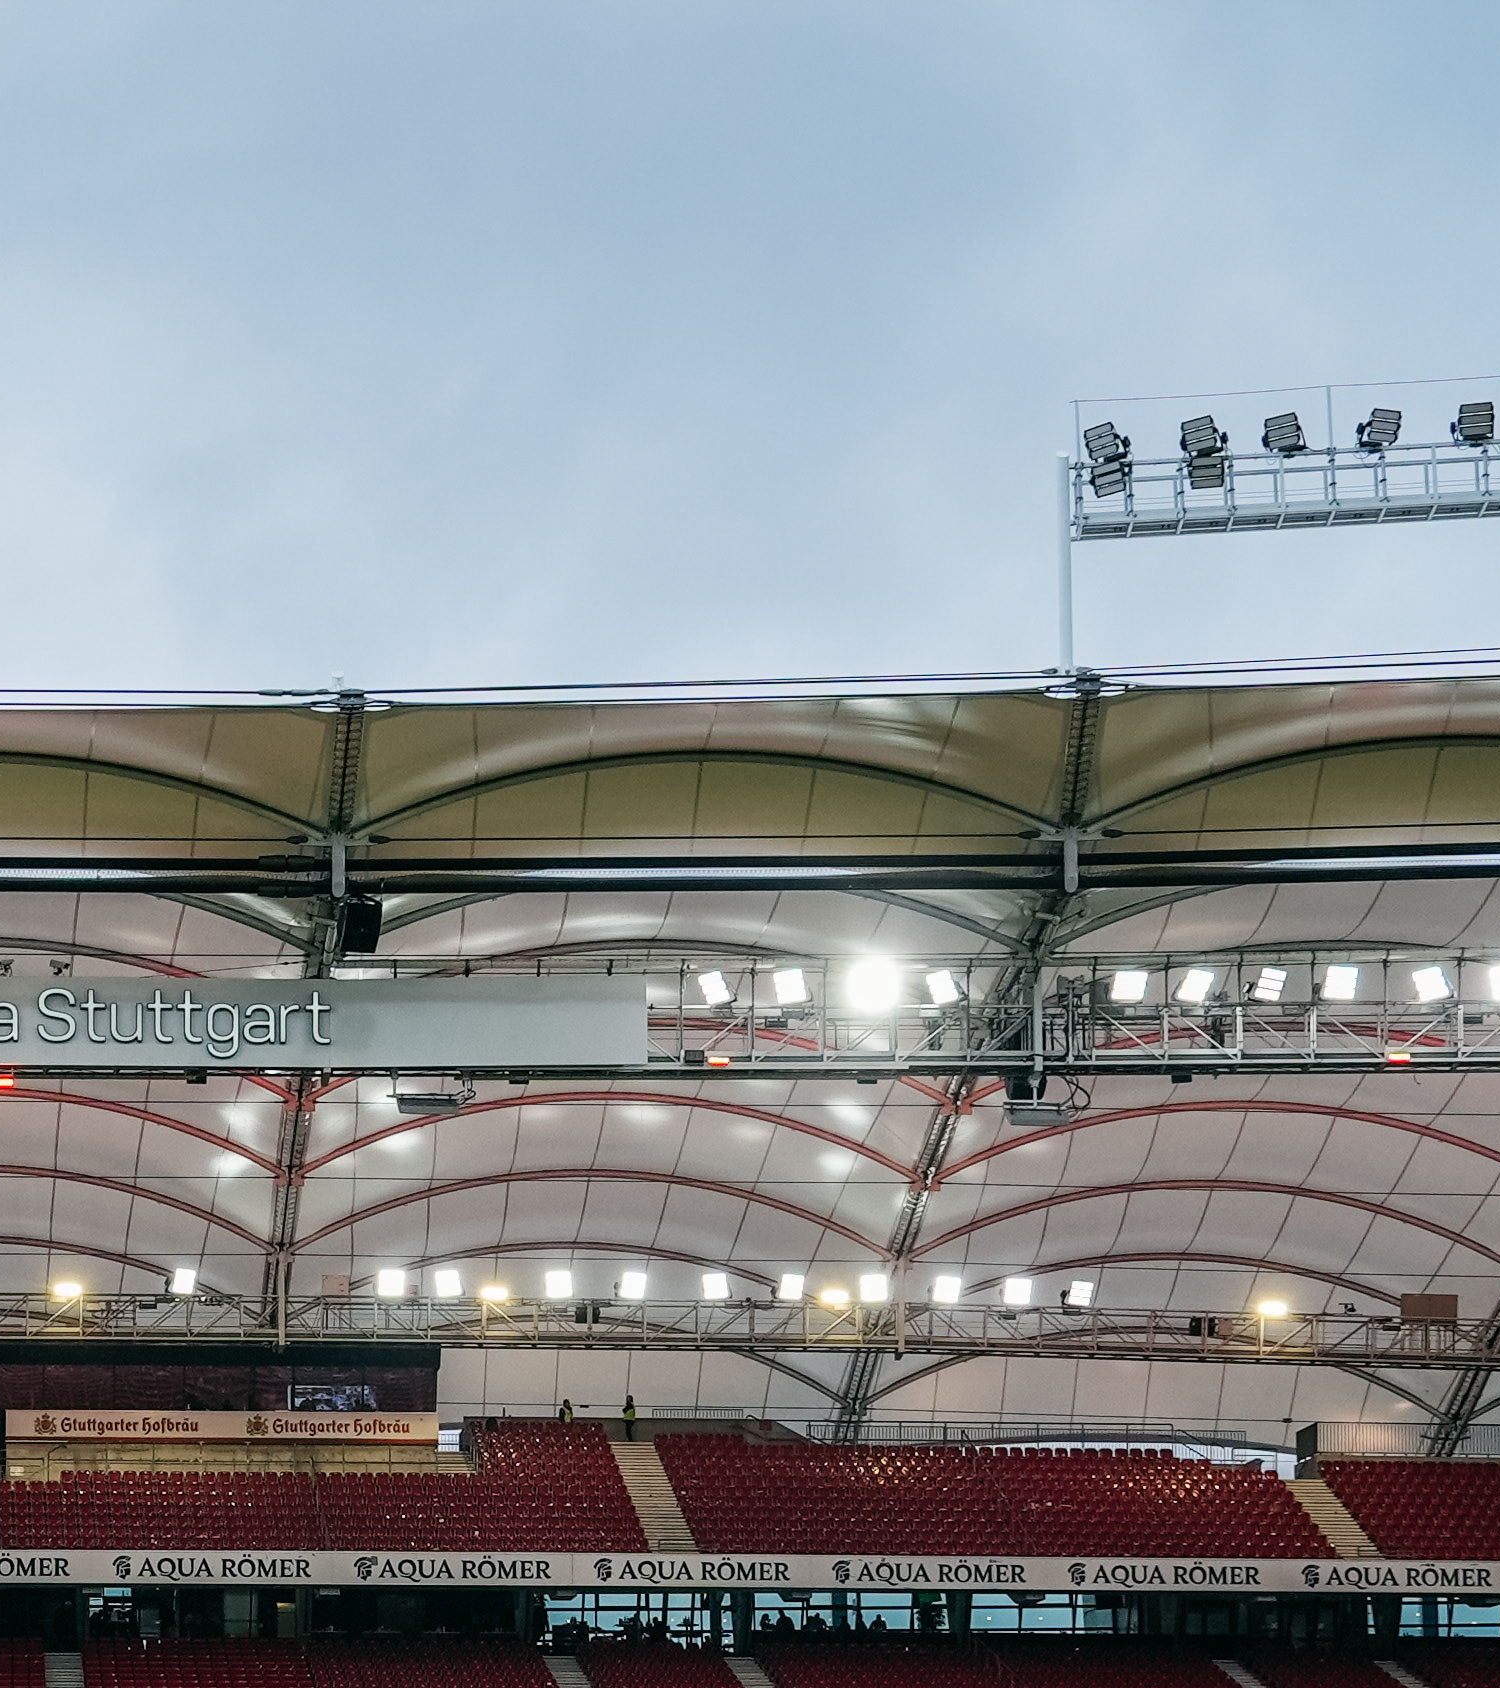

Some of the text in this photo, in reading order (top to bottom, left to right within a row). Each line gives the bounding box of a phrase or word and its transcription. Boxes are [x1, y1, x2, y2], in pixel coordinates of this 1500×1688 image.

[37, 987, 331, 1059] Stuttgart
[61, 1416, 199, 1435] Stuttgarter Hofbräu
[273, 1417, 410, 1436] Stuttgarter Hofbräu
[138, 1554, 311, 1580] AQUA RÖMER
[379, 1555, 551, 1582] AQUA RÖMER
[619, 1557, 790, 1584] AQUA RÖMER
[857, 1559, 1026, 1586] AQUA RÖMER
[1093, 1561, 1261, 1588] AQUA RÖMER
[1326, 1563, 1492, 1590] AQUA RÖMER
